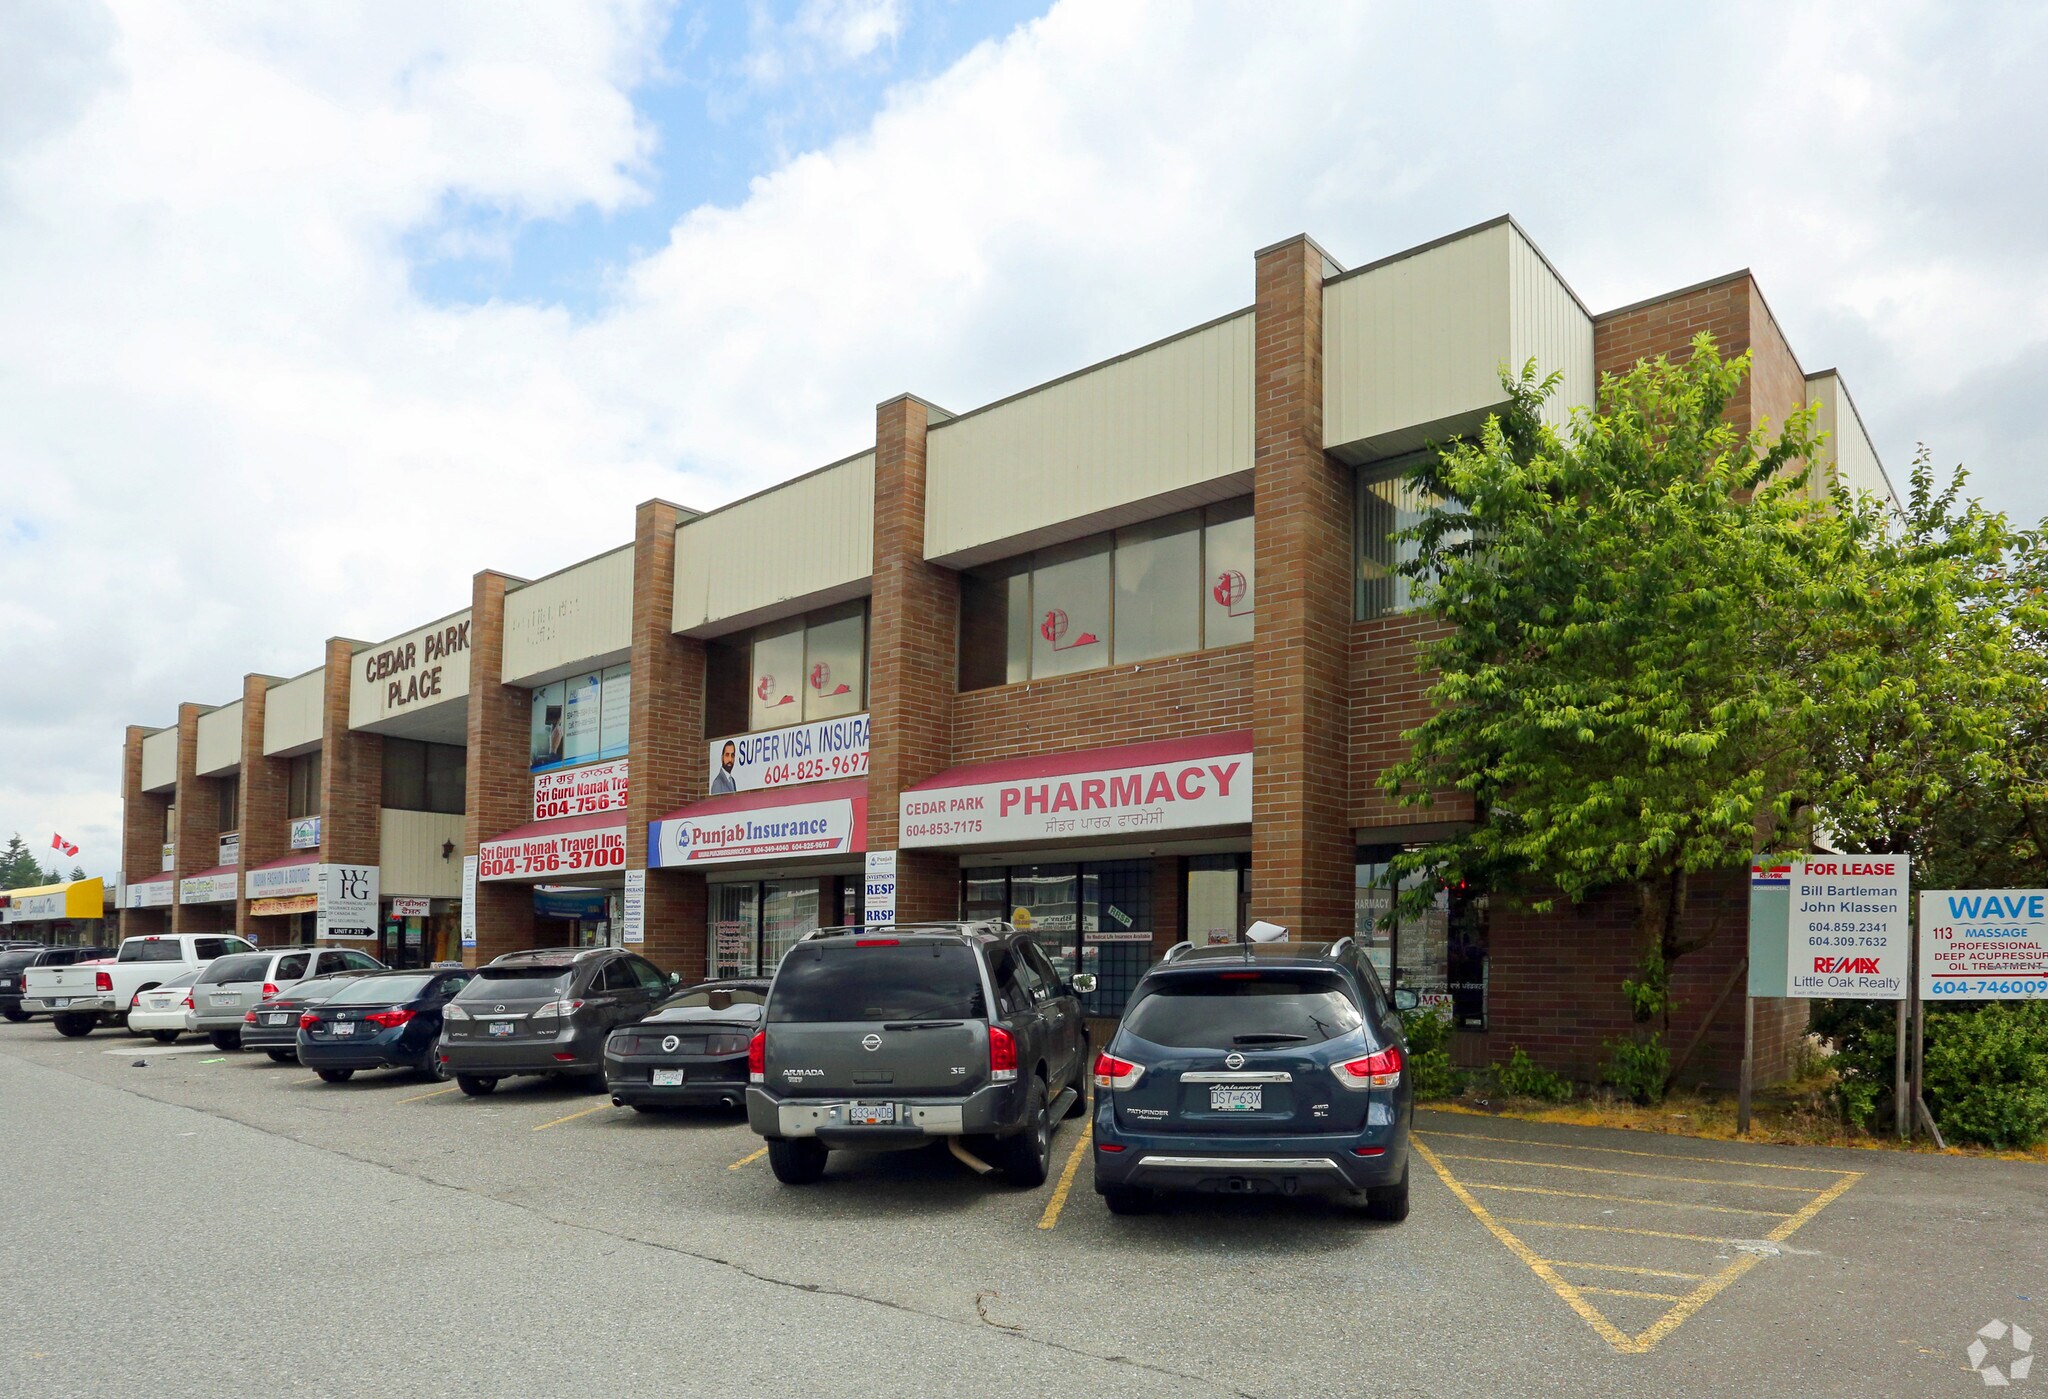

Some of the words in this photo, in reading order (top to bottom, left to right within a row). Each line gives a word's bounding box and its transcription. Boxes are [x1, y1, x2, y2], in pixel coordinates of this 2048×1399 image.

[366, 642, 416, 683] CEDAR
[425, 619, 470, 663] PARK
[388, 666, 441, 708] PLACE
[738, 734, 780, 766] SUPER
[782, 728, 812, 760] VISA
[764, 752, 869, 785] 604-825-9697
[536, 788, 550, 803] Sri
[551, 786, 575, 801] Guru
[576, 779, 609, 797] Nanak
[1000, 762, 1241, 818] PHARMACY
[906, 801, 947, 816] CEDAR
[950, 796, 985, 811] PARK
[692, 822, 745, 847] Punjab
[746, 818, 828, 840] Insurance
[906, 819, 983, 837] 604-853-7175
[480, 847, 495, 861] Sri
[496, 845, 521, 860] Guru
[523, 839, 559, 857] Nanak
[560, 834, 599, 853] Travel
[601, 833, 625, 849] Inc.
[480, 847, 625, 877] 604-756-3700
[1804, 863, 1838, 876] FOR
[1842, 863, 1895, 876] LEASE
[866, 883, 895, 895] RESP
[1801, 885, 1823, 896] Bill
[1827, 885, 1898, 897] Bartleman
[866, 909, 894, 921] RRSP
[1109, 906, 1132, 925] RRSP
[1800, 902, 1835, 913] John
[1840, 902, 1897, 913] Klassen
[1948, 896, 2045, 919] WAVE
[1808, 922, 1887, 933] 604.859.2341
[1932, 927, 1953, 940] 113
[1965, 928, 2028, 938] MASSAGE
[1808, 936, 1887, 947] 604.309.7632
[1950, 941, 2042, 950] PROFESSIONAL
[1934, 952, 1966, 960] DEEP
[1813, 956, 1880, 974] RE/MAX
[1949, 962, 1969, 971] OIL
[1971, 961, 2043, 970] TREATMENT
[1794, 975, 1824, 987] Little
[1827, 976, 1855, 988] Oak
[1858, 976, 1901, 992] Realty
[1932, 981, 2048, 995] 604-746009
[950, 1066, 967, 1075] SE
[1126, 1107, 1169, 1116] PATHFINDER
